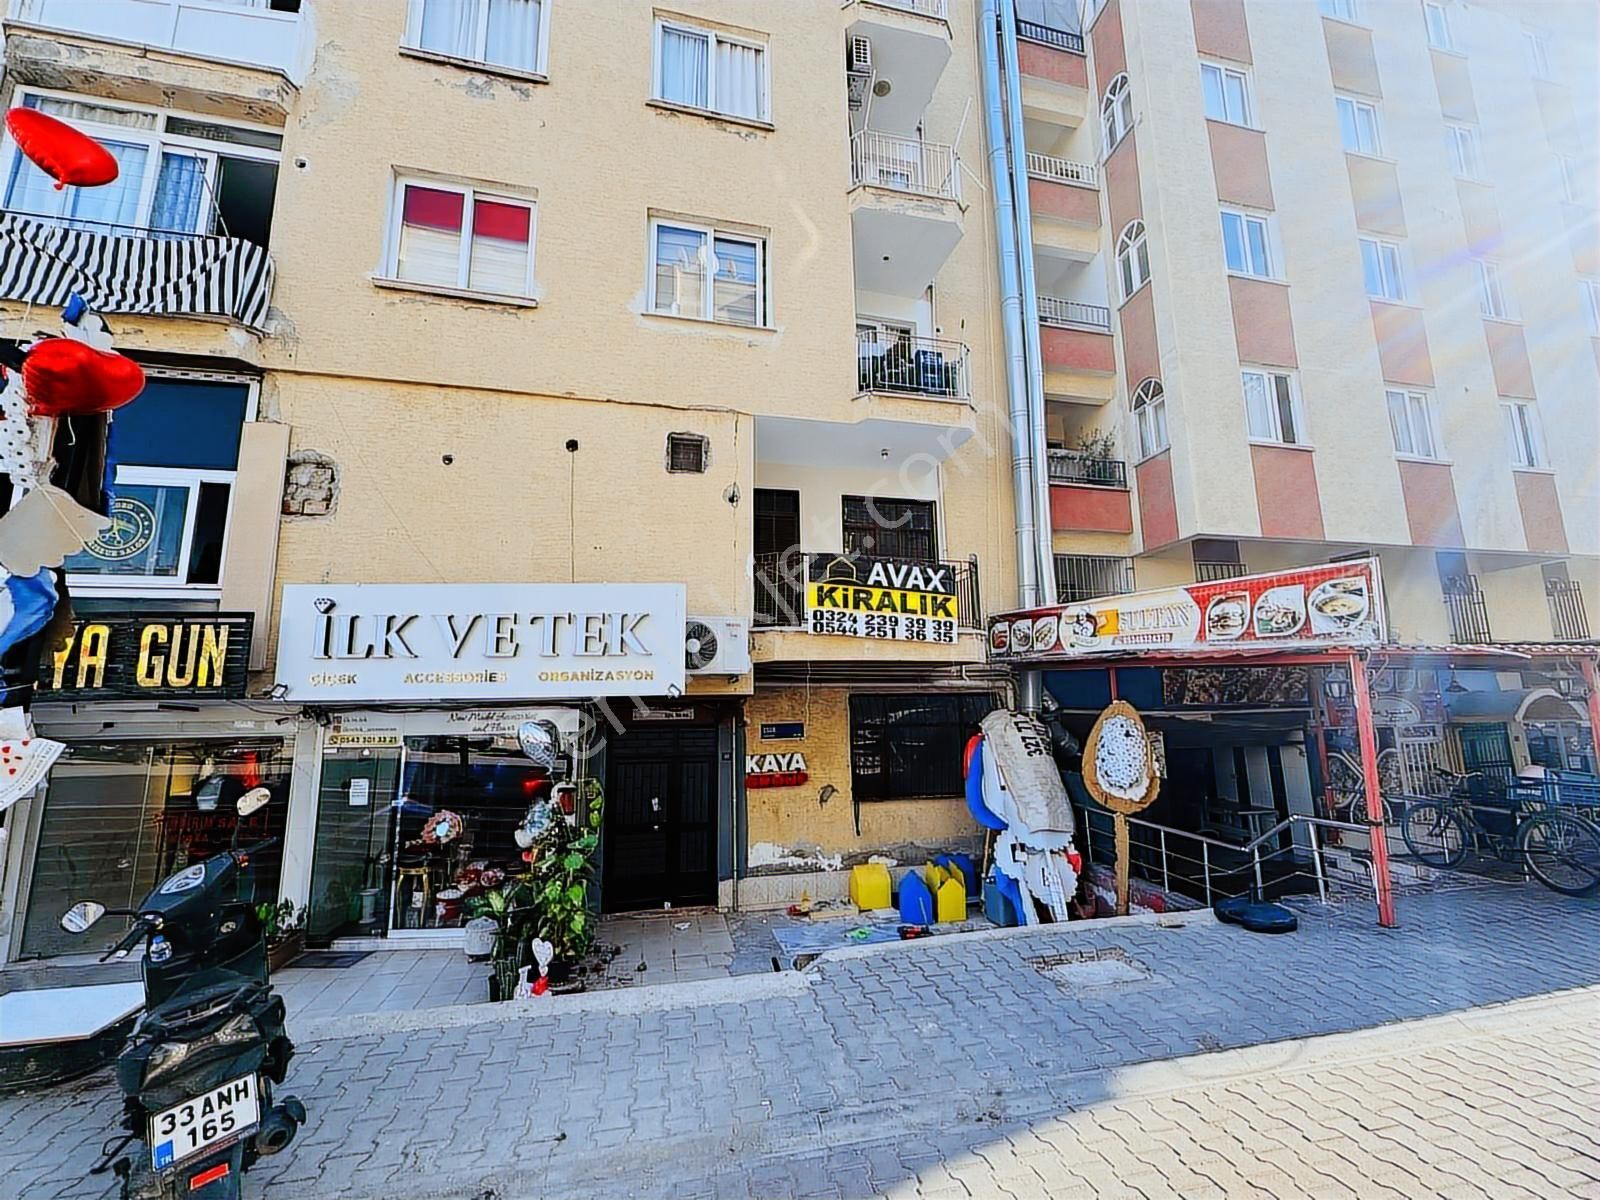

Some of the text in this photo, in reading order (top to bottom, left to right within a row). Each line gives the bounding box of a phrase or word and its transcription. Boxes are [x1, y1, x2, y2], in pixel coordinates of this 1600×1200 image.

[866, 562, 946, 592] AVAX
[812, 610, 954, 631] 0324 239 39 39
[812, 621, 954, 643] 0544 251 36 35
[136, 624, 229, 688] GUN
[745, 752, 807, 773] KAYA
[161, 1080, 249, 1135] 33 ANH
[187, 1110, 236, 1147] 165
